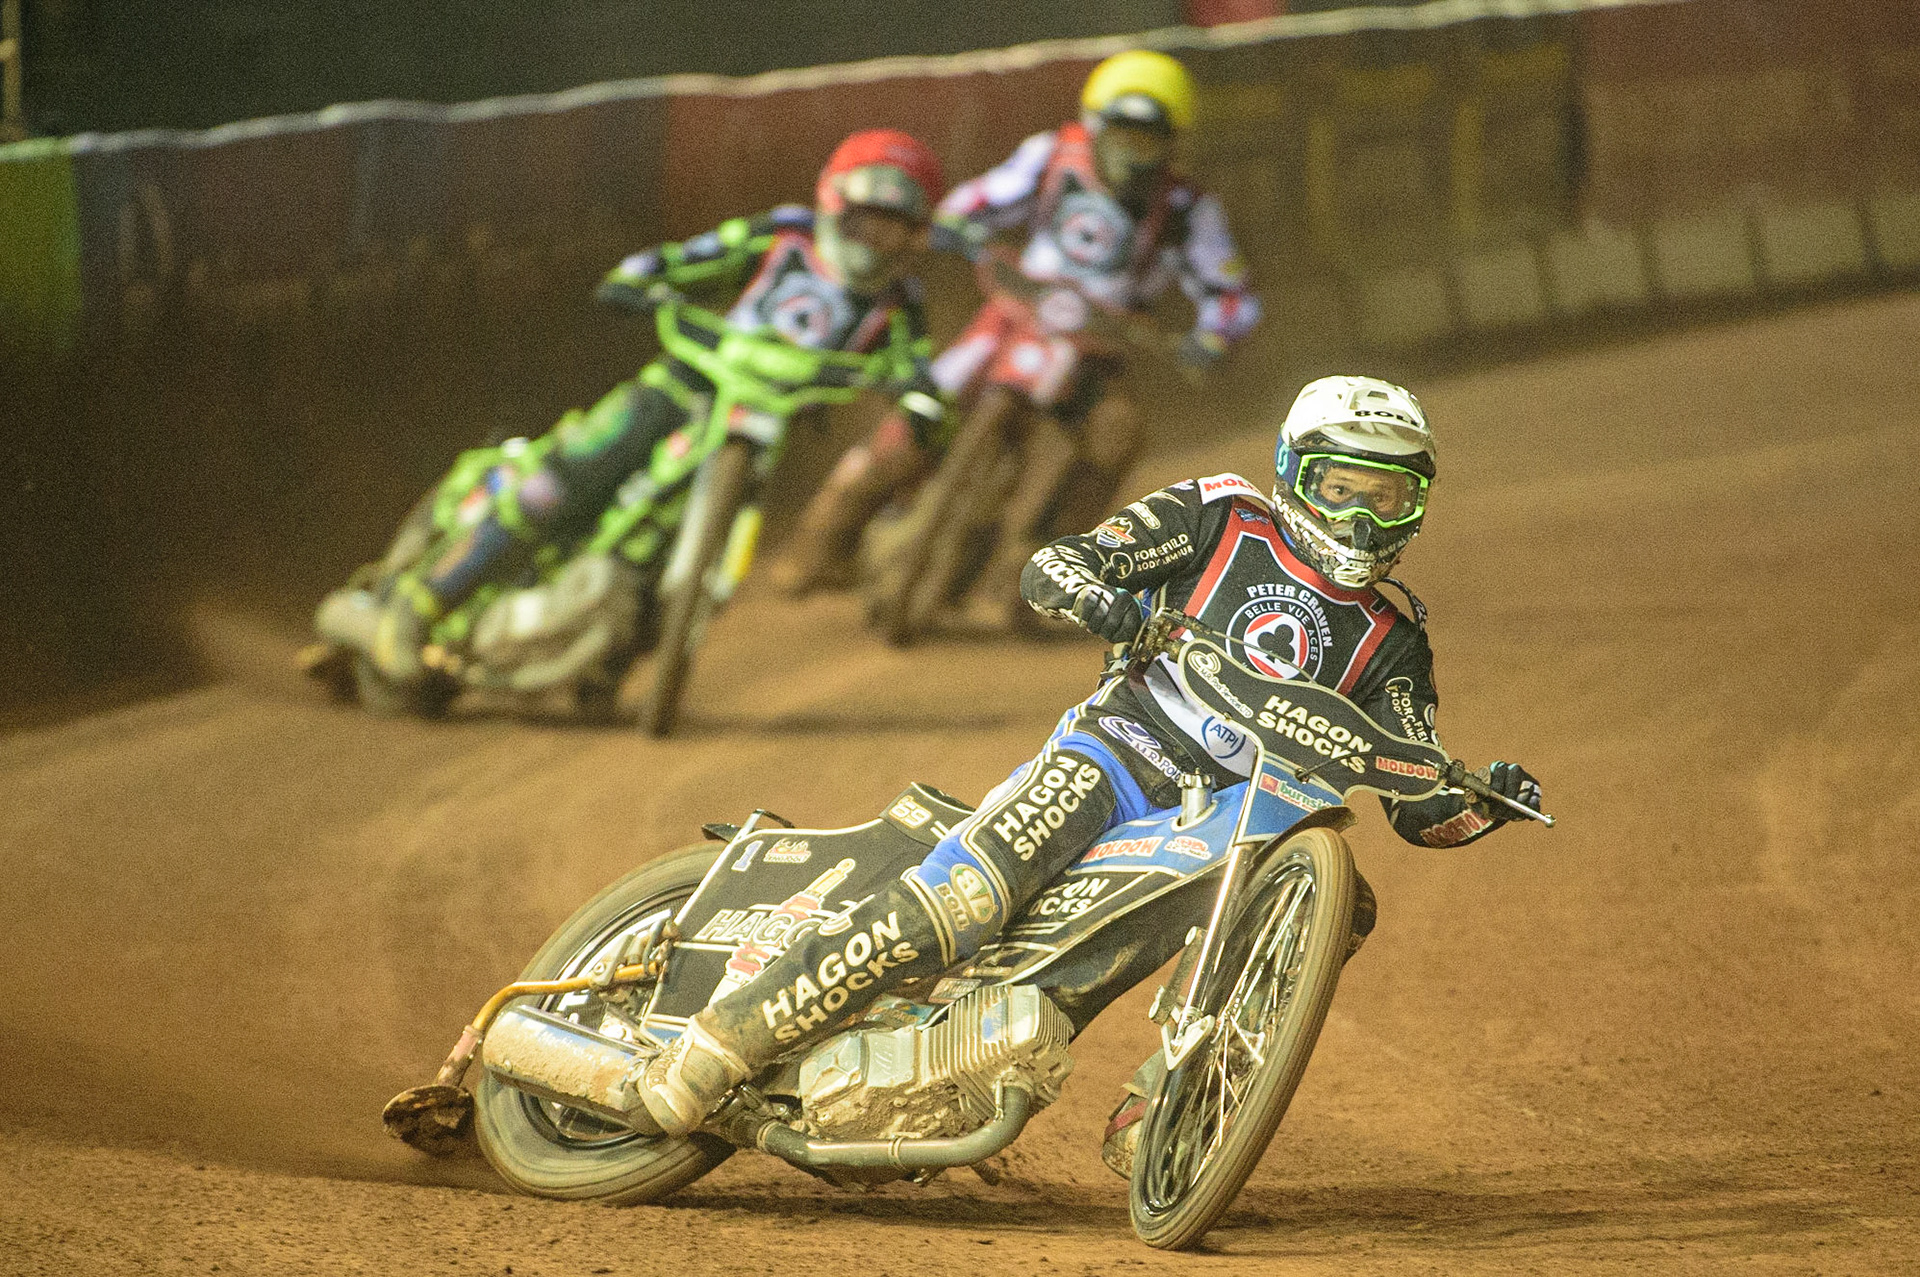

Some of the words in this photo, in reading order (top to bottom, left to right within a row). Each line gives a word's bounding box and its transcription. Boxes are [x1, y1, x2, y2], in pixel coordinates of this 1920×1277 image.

[1031, 546, 1088, 594] SHOCK
[1244, 602, 1282, 619] BELLE
[1288, 604, 1310, 625] VUE
[1307, 629, 1319, 661] ACES
[1246, 584, 1296, 598] PETER
[1298, 589, 1333, 647] CRAVEN
[1209, 724, 1239, 749] ATPI
[1256, 711, 1366, 774] SHOCKS
[1264, 695, 1373, 753] HAGON
[1400, 718, 1418, 742] ARMO
[1376, 756, 1439, 781] MOLDOW
[993, 756, 1078, 843] HAGON
[1013, 764, 1101, 861] SHOCKS
[1082, 838, 1161, 863] MOLDOW
[692, 908, 823, 948] HAGO
[762, 911, 901, 1029] HAGON
[773, 941, 919, 1043] SHOCKS
